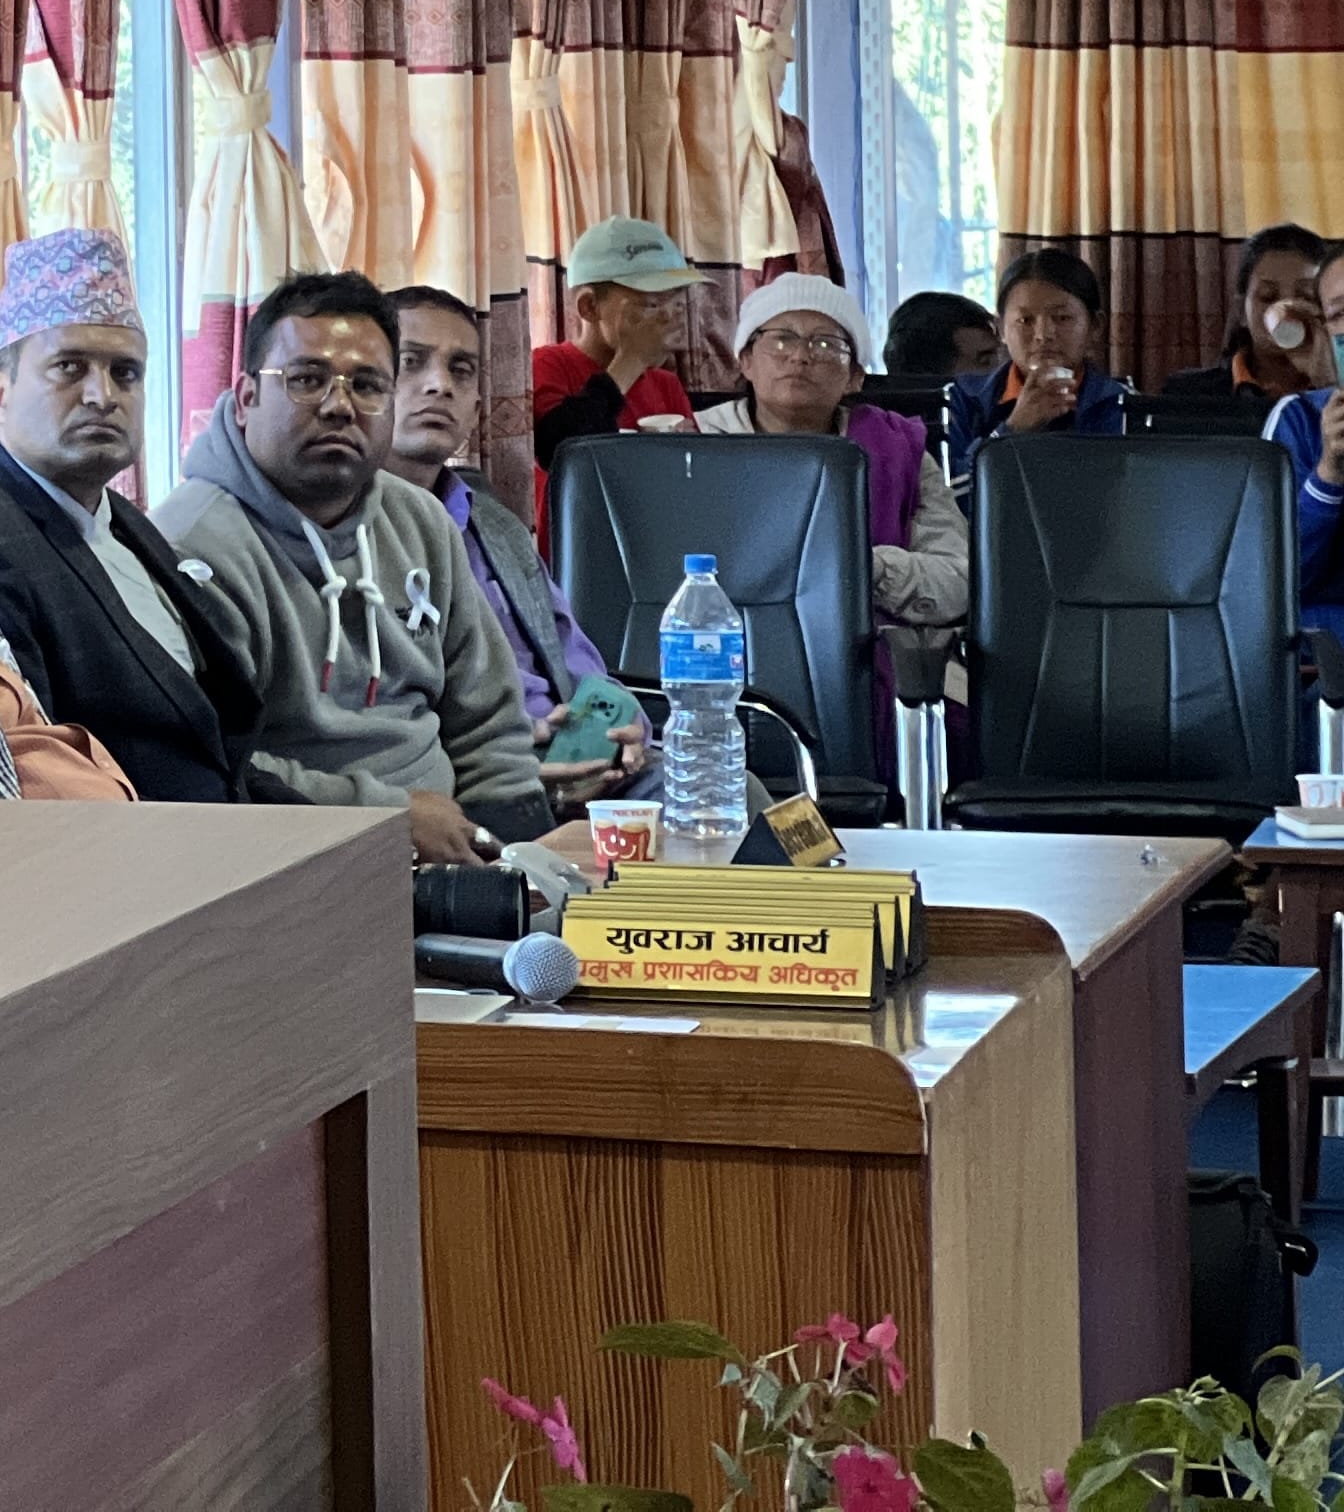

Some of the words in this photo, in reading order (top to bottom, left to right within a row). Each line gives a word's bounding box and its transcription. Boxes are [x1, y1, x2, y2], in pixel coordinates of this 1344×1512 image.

[606, 927, 716, 954] युवराज
[725, 928, 830, 954] आचार्य
[768, 962, 860, 991] अधिकृत
